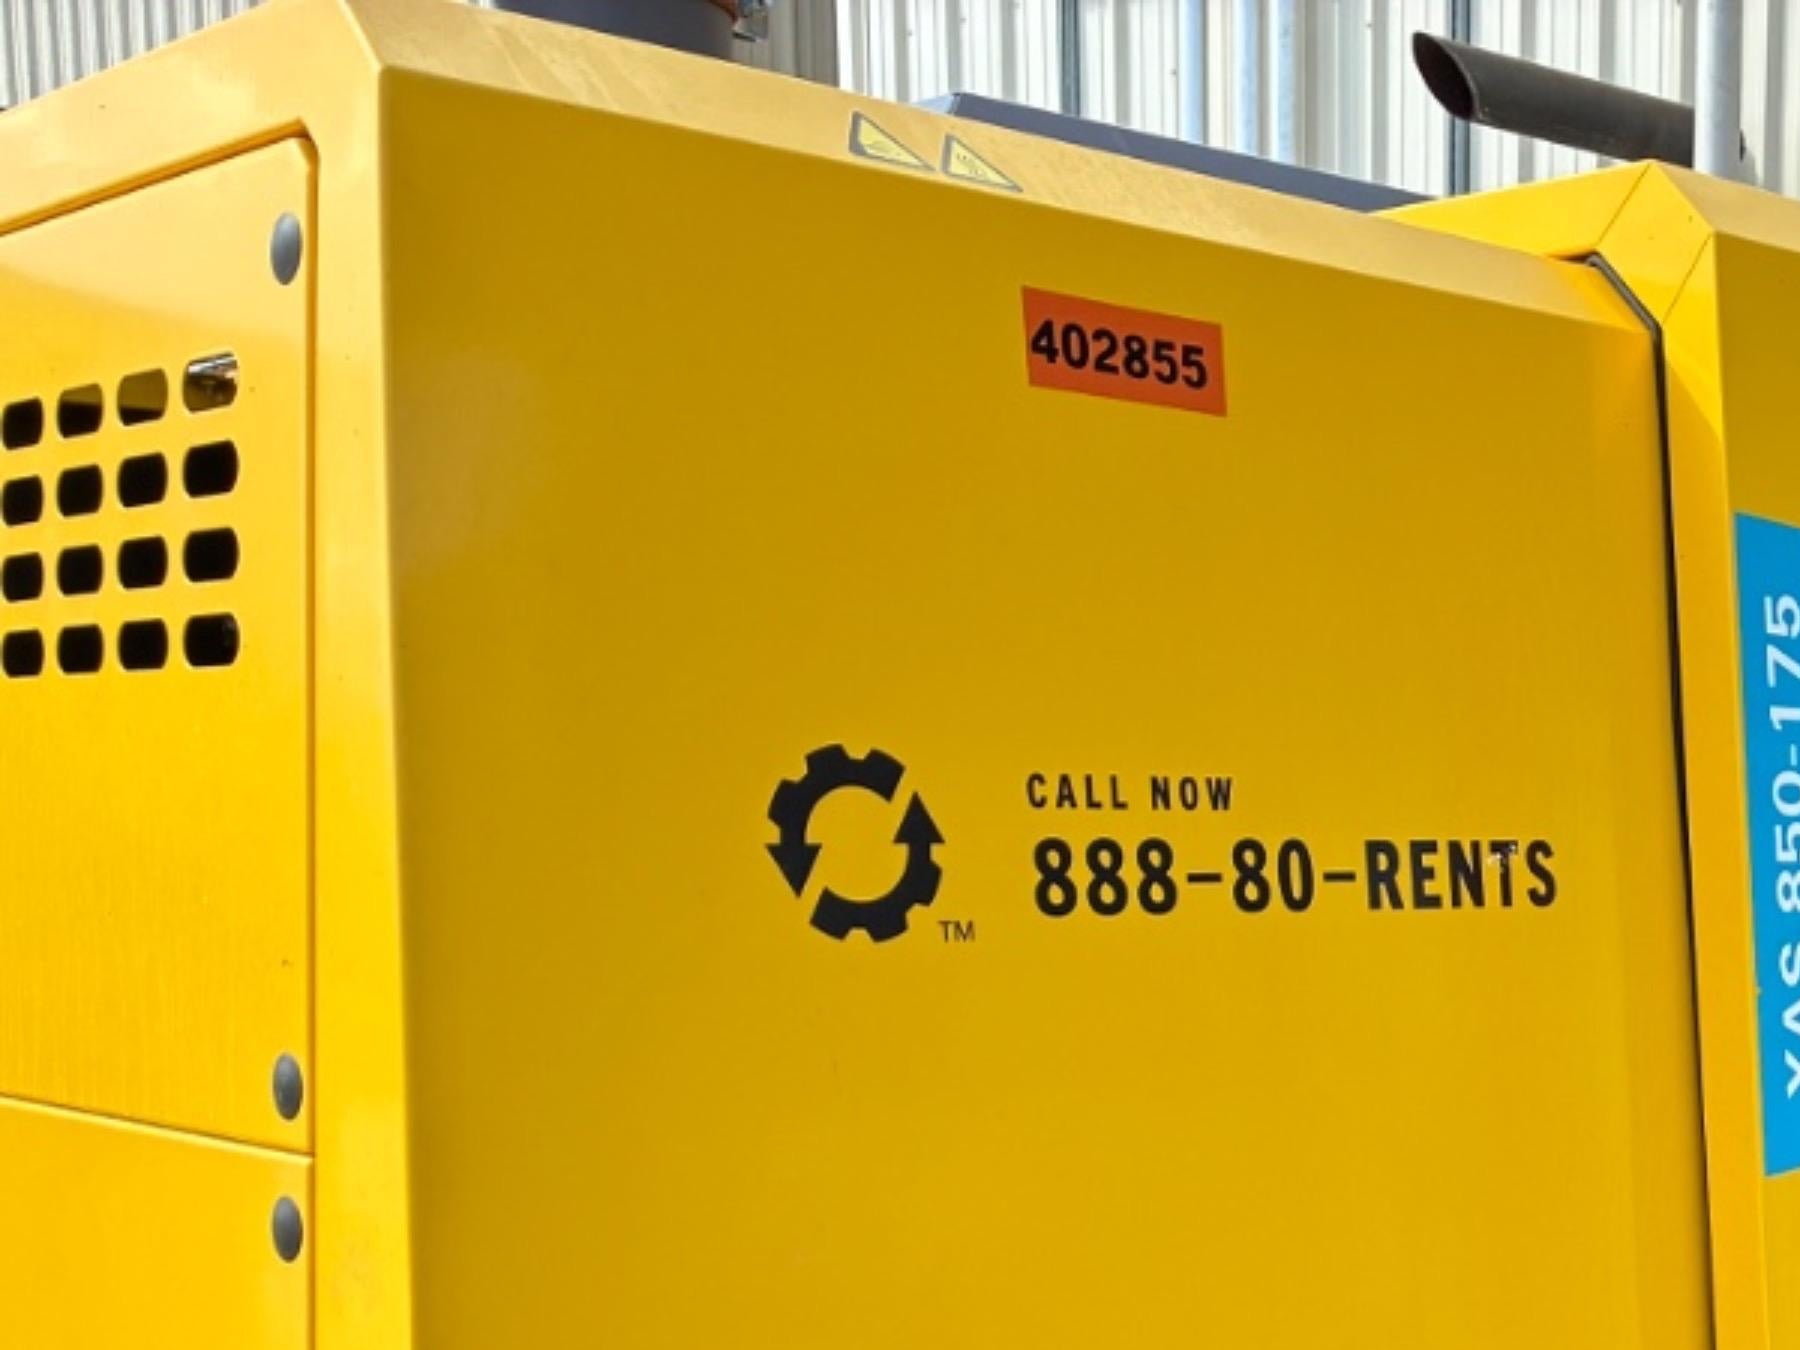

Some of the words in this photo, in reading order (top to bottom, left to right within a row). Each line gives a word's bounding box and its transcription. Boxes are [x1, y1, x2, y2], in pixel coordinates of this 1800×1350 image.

[1029, 318, 1209, 391] 402855
[1026, 773, 1128, 810] CALL
[1150, 776, 1233, 812] NOW
[1033, 836, 1557, 918] 888-80-RENTS
